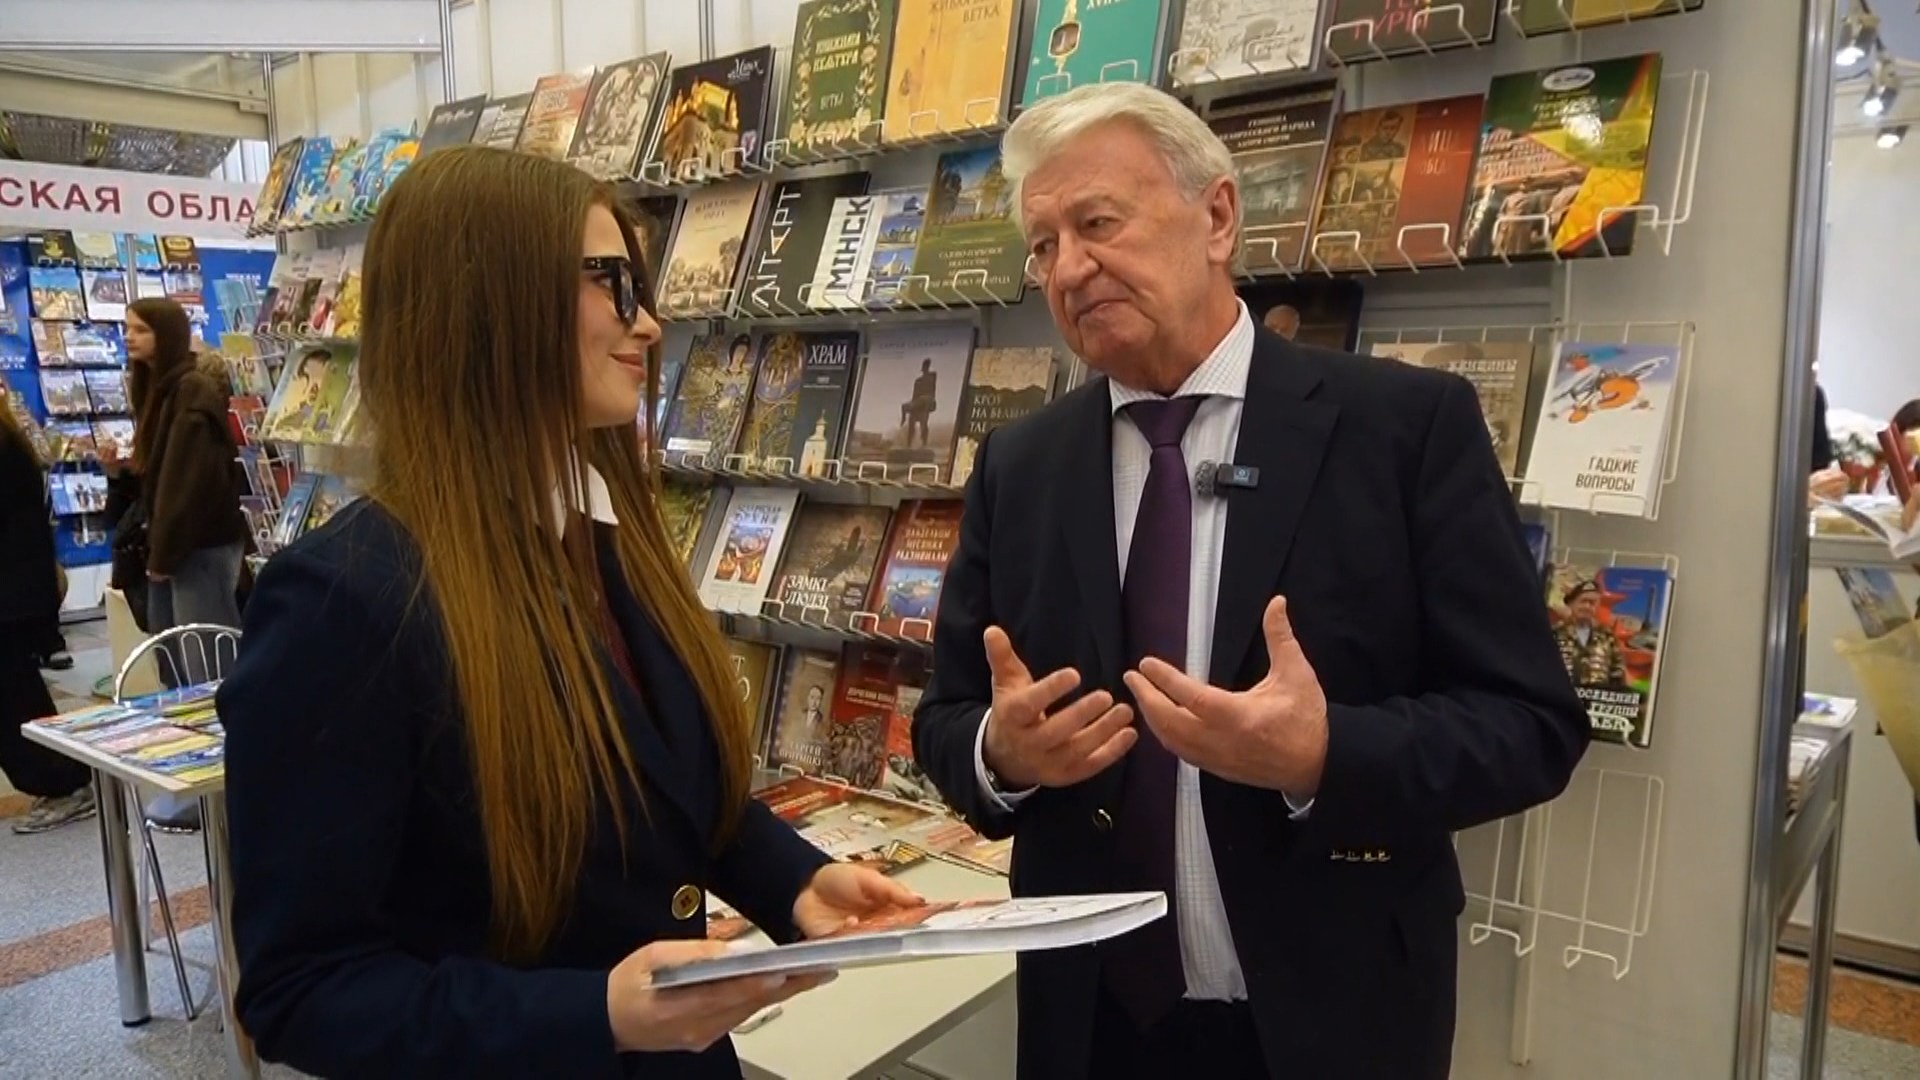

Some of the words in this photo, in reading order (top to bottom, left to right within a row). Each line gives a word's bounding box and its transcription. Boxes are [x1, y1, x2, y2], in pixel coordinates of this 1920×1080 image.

[963, 5, 1000, 24] ВЕТКА
[0, 177, 121, 214] СКАЯ
[826, 195, 872, 291] МІНСК
[808, 344, 848, 365] ХРАМ
[1588, 455, 1639, 474] ГАДКИЕ
[1575, 472, 1635, 492] ВОПРОСЫ
